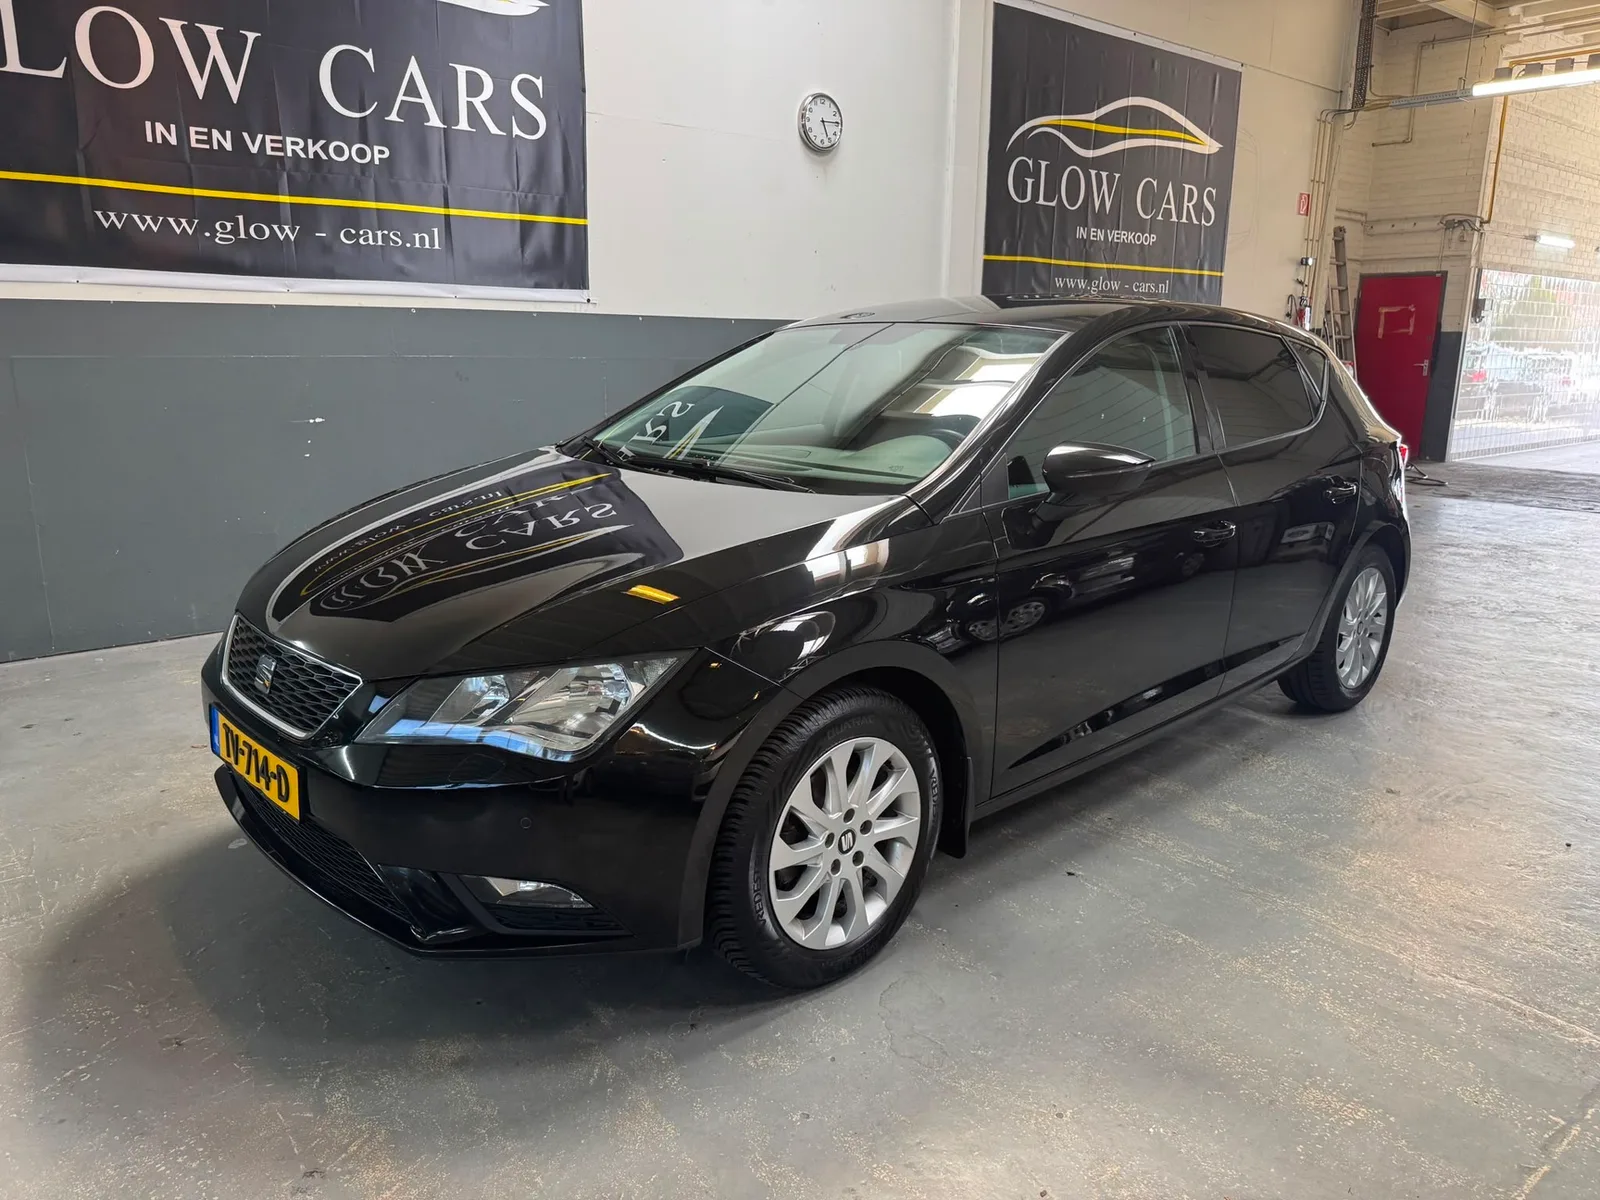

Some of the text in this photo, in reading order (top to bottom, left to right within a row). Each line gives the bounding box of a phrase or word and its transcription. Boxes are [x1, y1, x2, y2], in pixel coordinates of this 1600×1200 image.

[318, 44, 548, 141] CARS
[145, 120, 391, 166] IN EN VERKOOP
[1007, 156, 1217, 227] GLOW CARS
[94, 209, 301, 245] www.glow
[339, 227, 443, 251] cars.nl
[1076, 226, 1157, 246] IN EN VERKOOP
[1054, 276, 1121, 295] www.glow
[1132, 279, 1169, 294] cars.nl
[222, 722, 290, 803] TV-714-D
